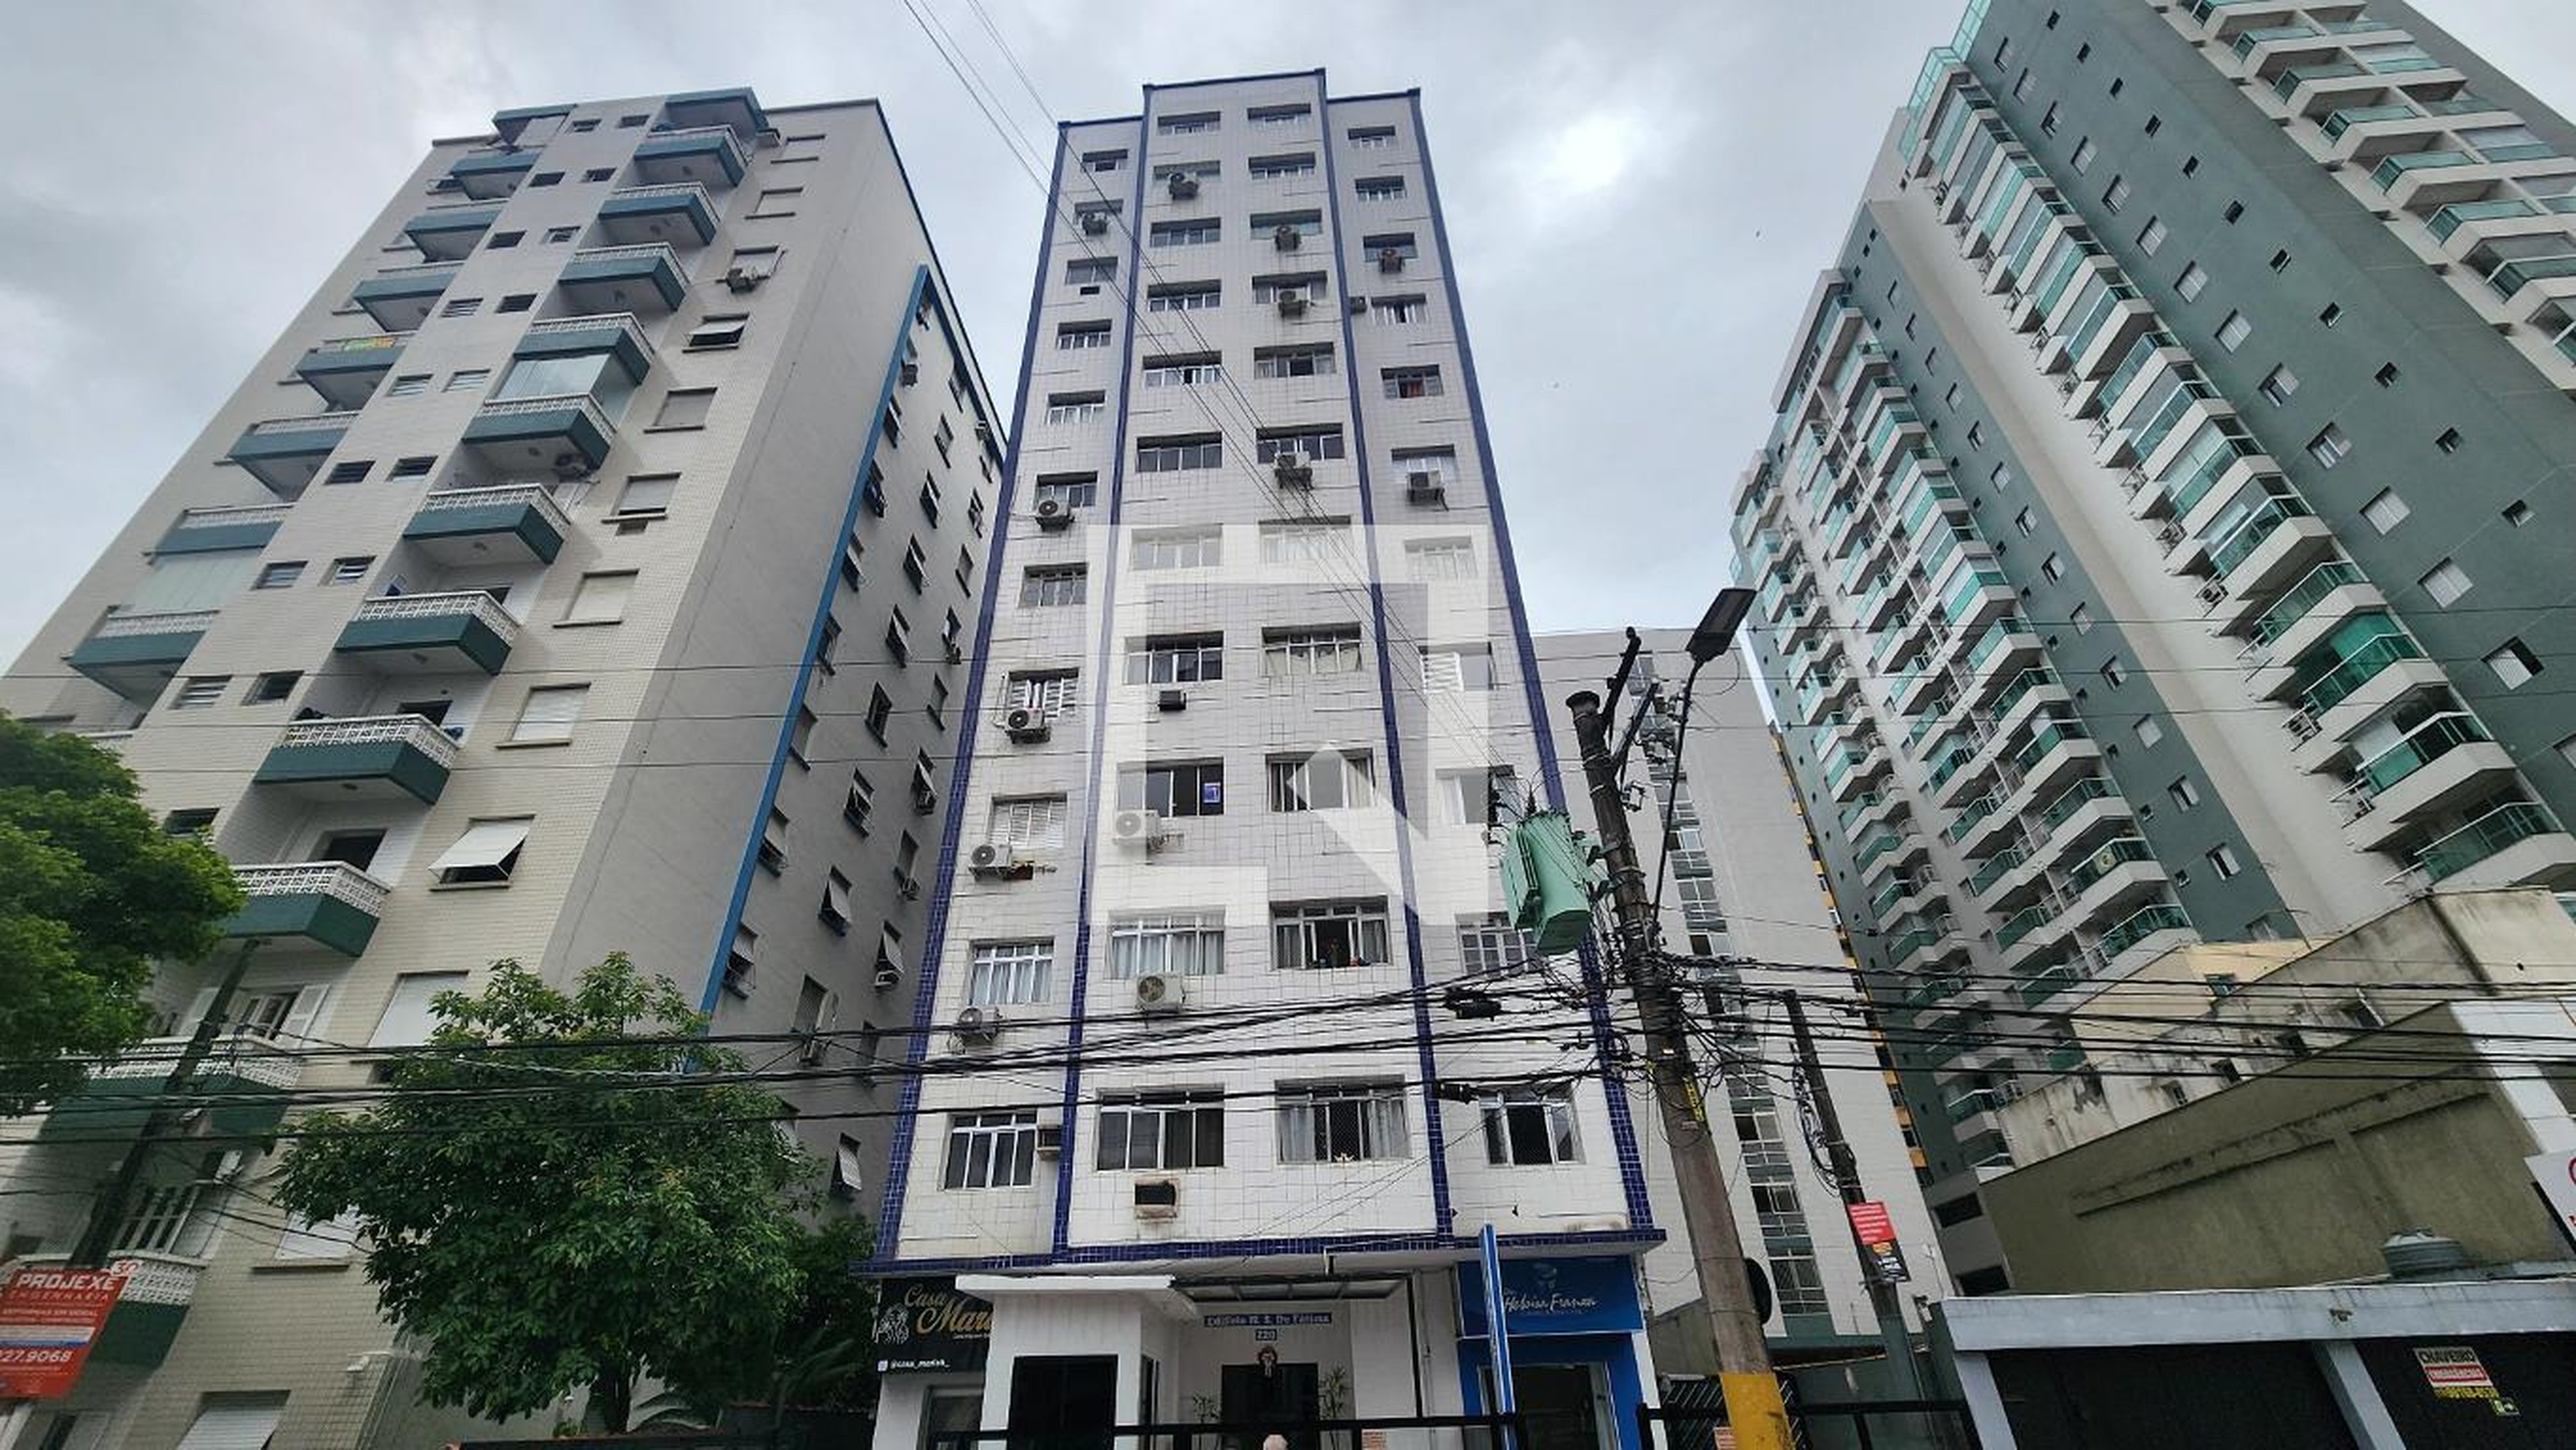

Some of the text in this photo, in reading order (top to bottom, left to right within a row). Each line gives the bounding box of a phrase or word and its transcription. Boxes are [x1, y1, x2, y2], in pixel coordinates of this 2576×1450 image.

[16, 1274, 118, 1290] PROJEXE
[905, 1284, 947, 1306] Casa
[1256, 1330, 1275, 1340] 220
